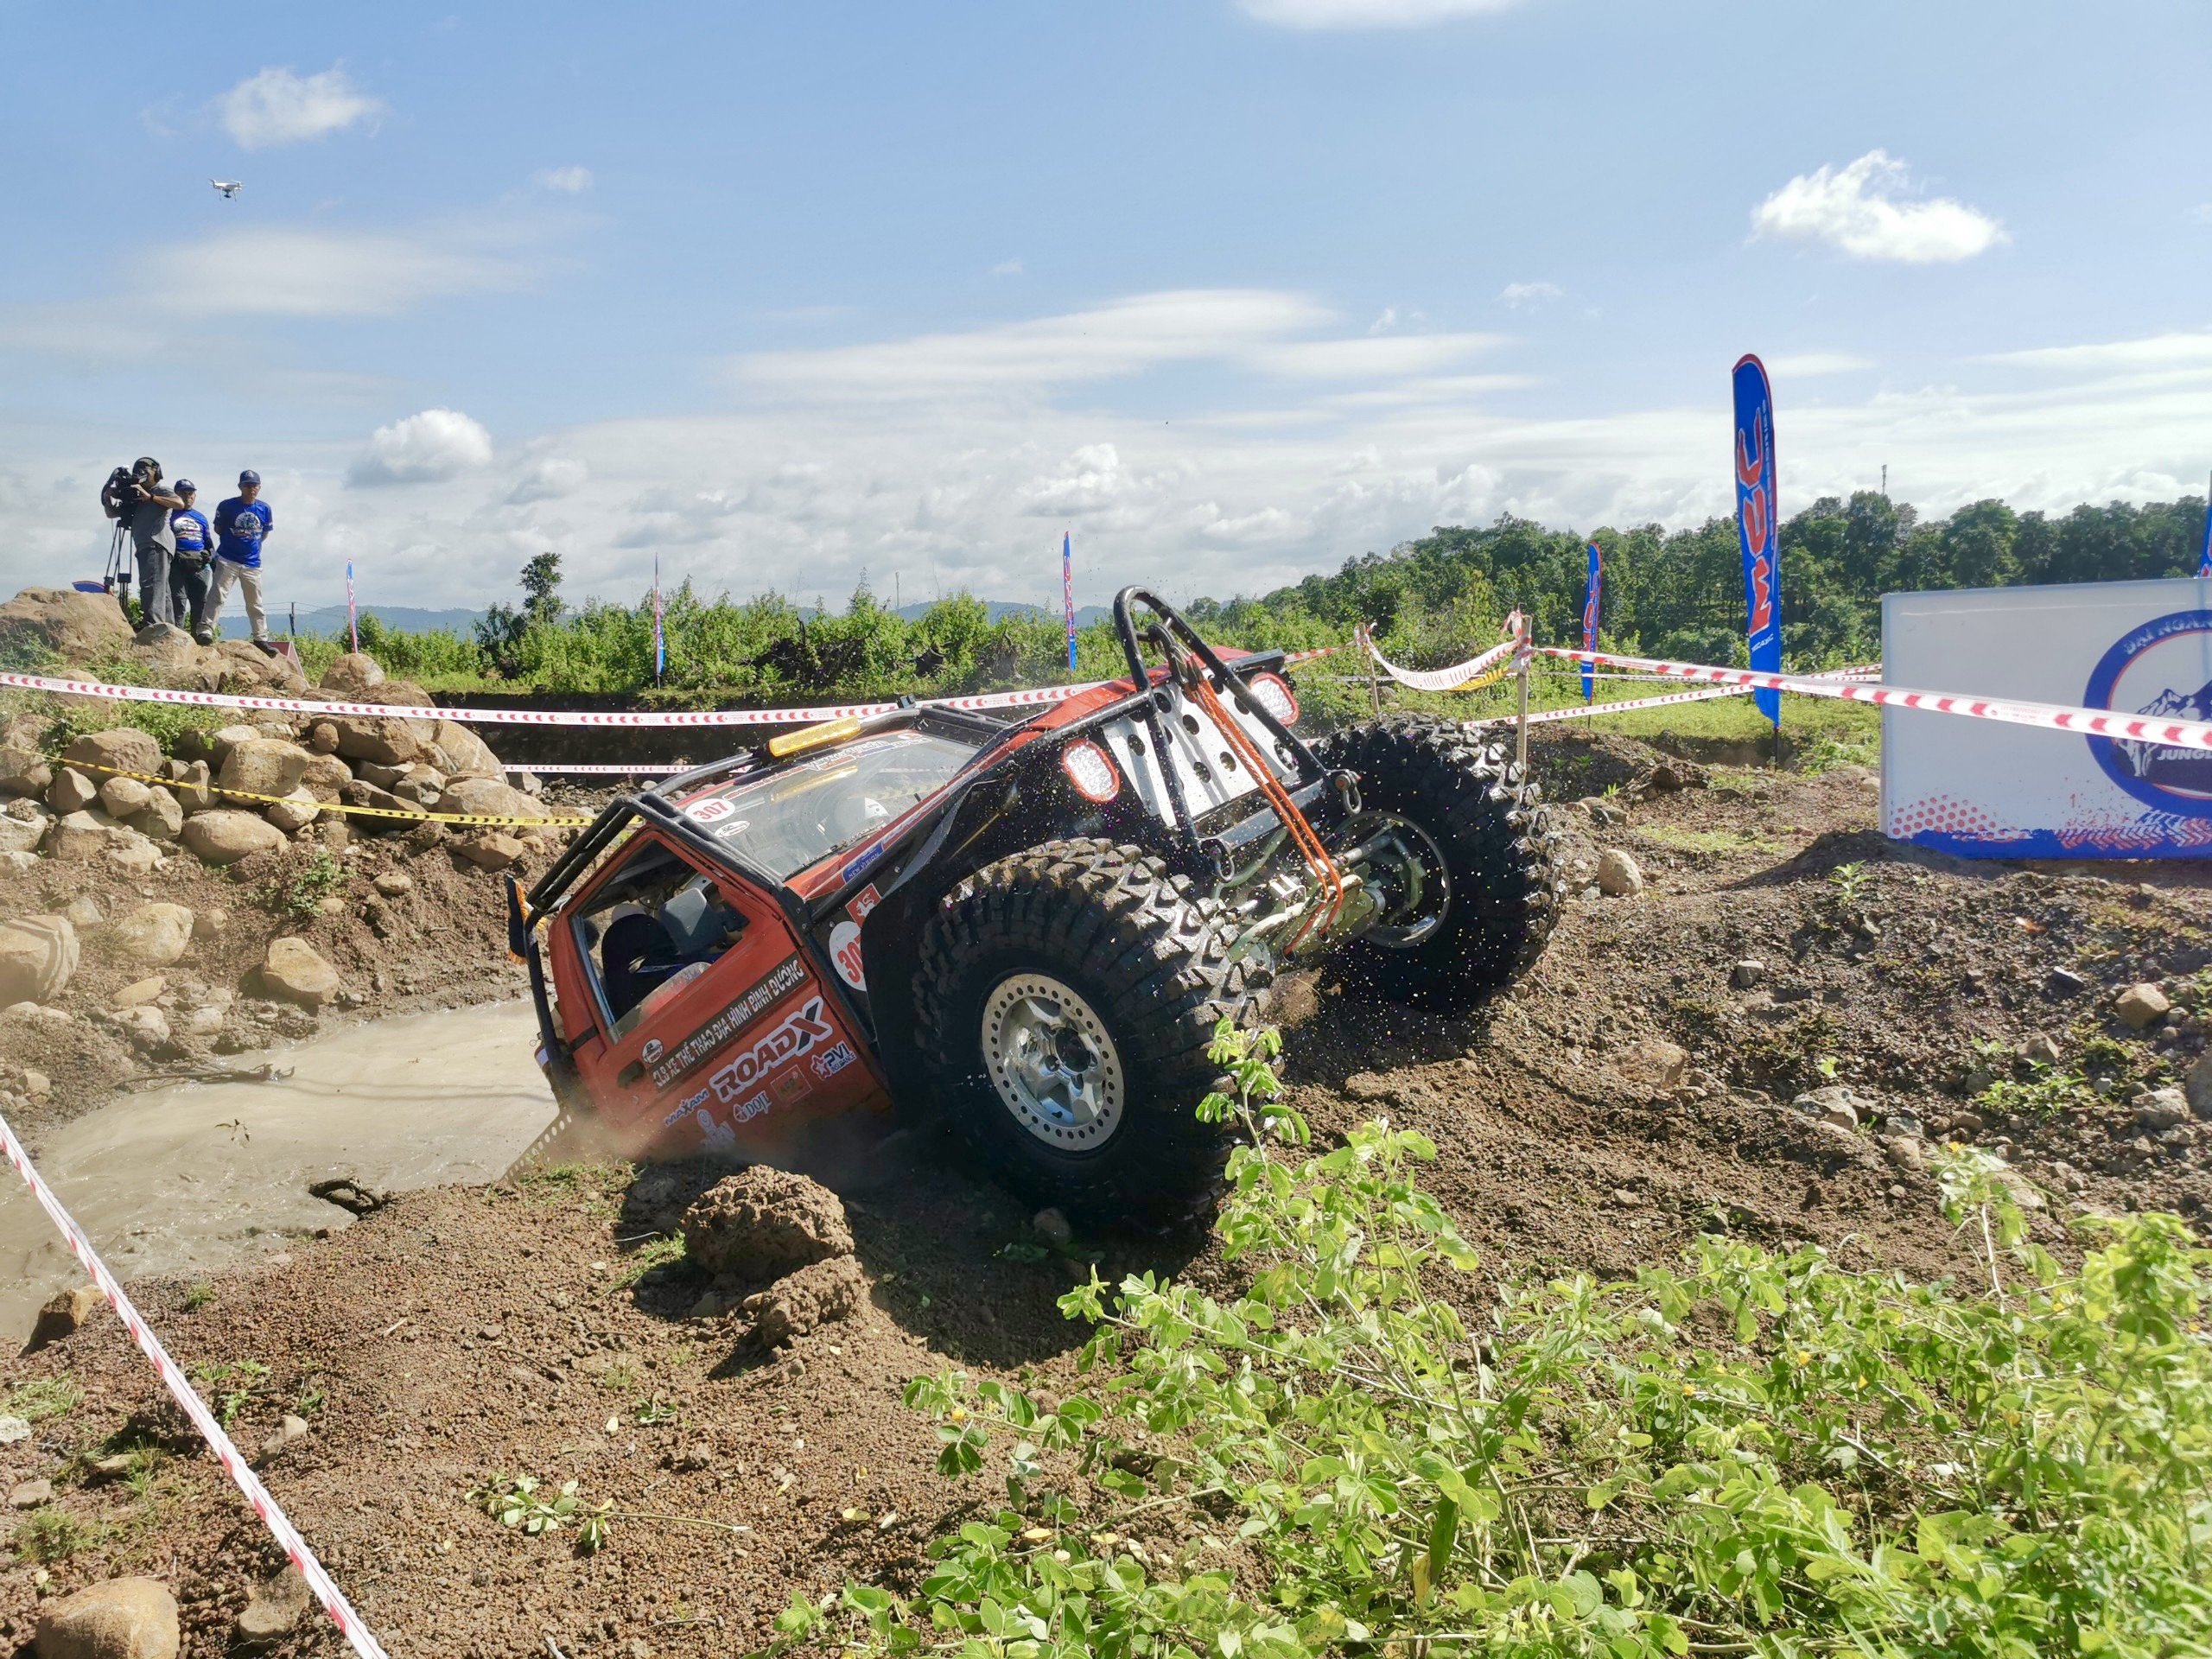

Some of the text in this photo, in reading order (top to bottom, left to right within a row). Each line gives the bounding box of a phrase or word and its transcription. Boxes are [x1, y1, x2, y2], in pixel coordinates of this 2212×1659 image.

[692, 801, 728, 820] 307
[848, 852, 880, 879] NEW VISION
[652, 1066, 671, 1087] CLB
[665, 1058, 681, 1077] XE
[690, 1029, 716, 1056] THAO
[727, 1001, 752, 1028] HÌNH
[747, 984, 772, 1013] BÌNH
[711, 999, 830, 1101] ROADX
[823, 1042, 850, 1066] PVI
[830, 1052, 856, 1072] INSURANCE
[664, 1089, 709, 1125] MAXAM
[745, 1091, 771, 1116] DOJI
